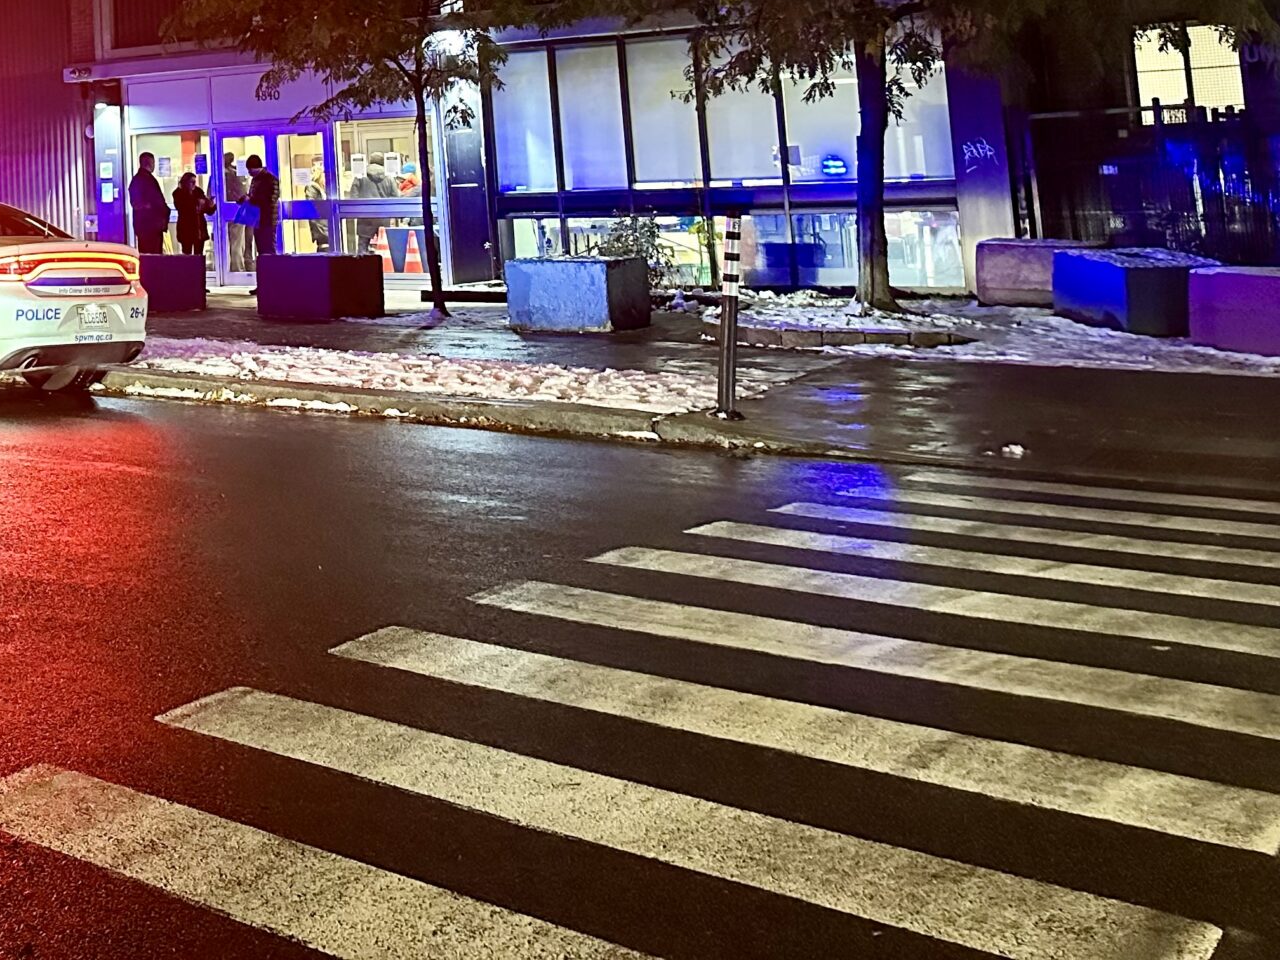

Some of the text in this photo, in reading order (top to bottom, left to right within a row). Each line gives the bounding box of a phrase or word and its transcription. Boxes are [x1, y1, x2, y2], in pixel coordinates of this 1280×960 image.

[15, 308, 61, 321] POLICE
[130, 306, 145, 319] 26-4
[74, 333, 113, 343] spvm.qc.ca
